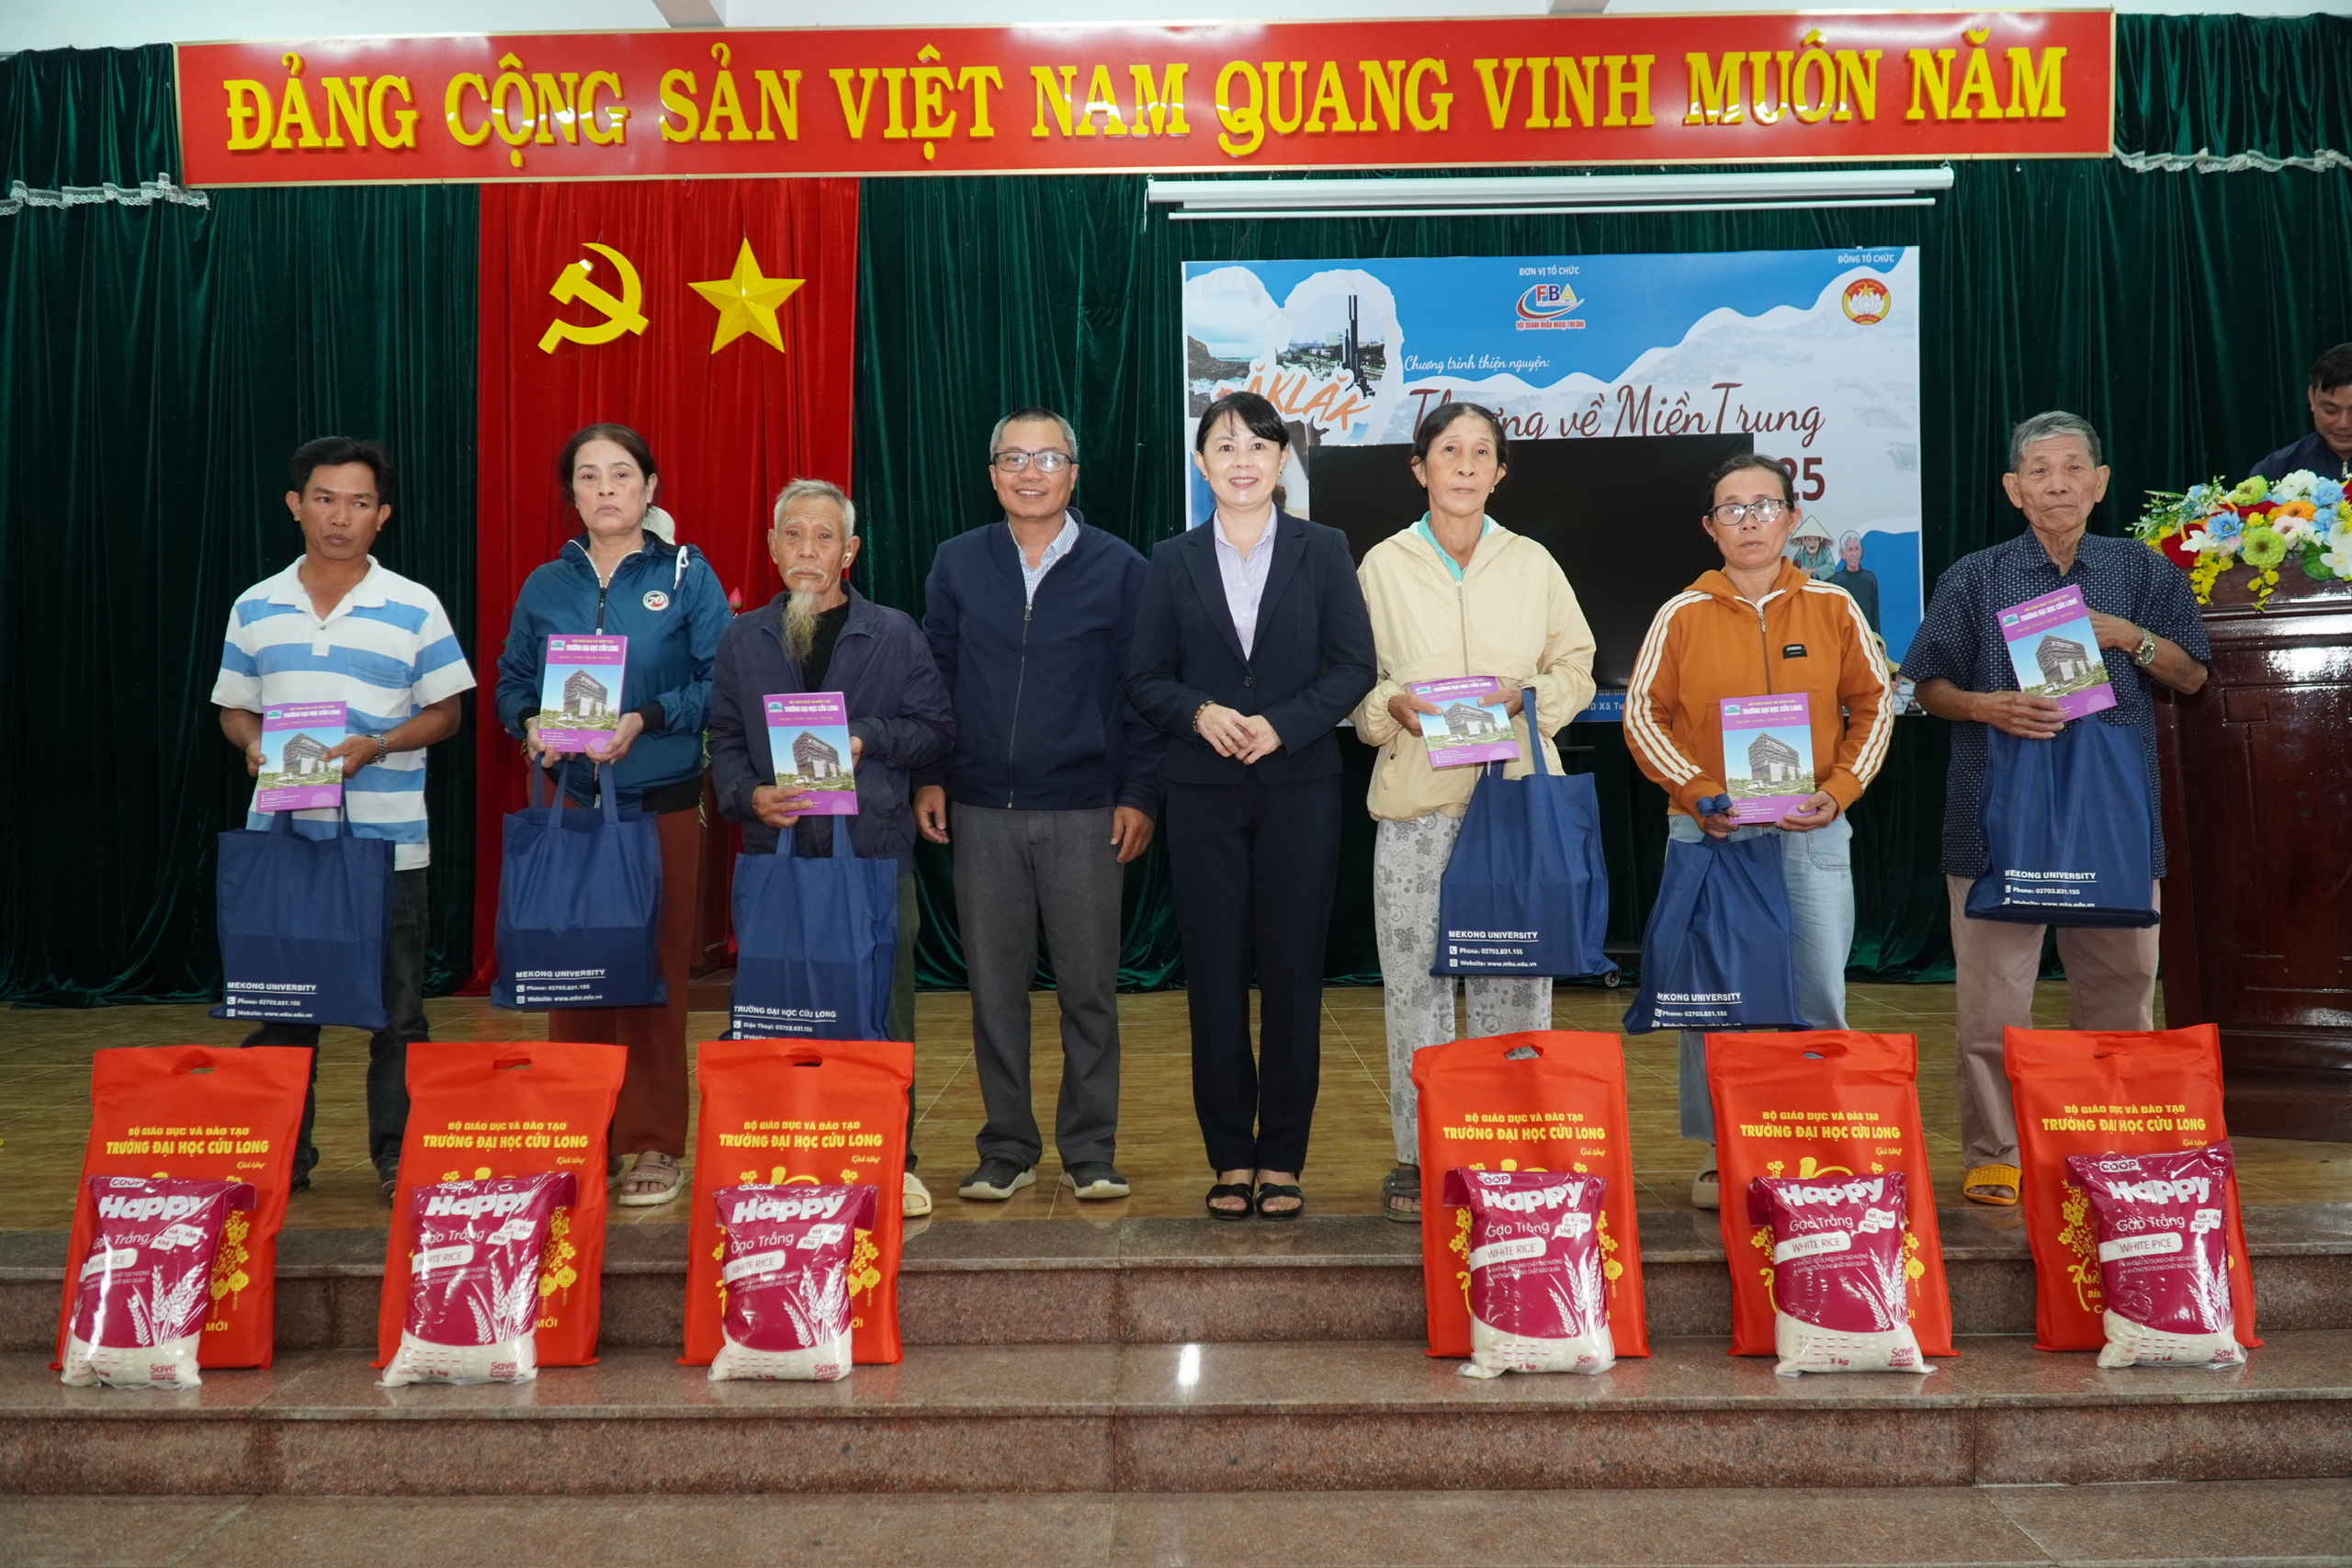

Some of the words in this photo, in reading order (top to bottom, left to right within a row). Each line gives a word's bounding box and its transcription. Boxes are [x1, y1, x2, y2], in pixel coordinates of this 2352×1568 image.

[224, 51, 417, 152] ĐẢNG
[446, 51, 630, 169] CỘNG
[659, 42, 800, 142] SẢN
[830, 42, 1003, 162] VIỆT
[1031, 63, 1191, 141] NAM
[1215, 58, 1454, 158] QUANG
[1474, 53, 1656, 131] VINH
[1683, 28, 1883, 127] MUÔN
[1905, 28, 2066, 122] NĂM
[1838, 254, 1860, 263] ĐỒNG
[1861, 253, 1871, 262] TỔ
[1873, 253, 1894, 262] CHỨC
[1520, 267, 1536, 276] ĐƠN
[1538, 267, 1545, 276] VỊ
[1547, 265, 1556, 275] TỔ
[1558, 265, 1579, 275] CHỨC
[1536, 284, 1577, 301] FBA
[1405, 355, 1445, 374] Chương
[1448, 355, 1476, 369] trình
[1478, 354, 1507, 371] thiện
[1509, 355, 1550, 372] nguyện:
[1712, 382, 1826, 447] Trung
[555, 969, 605, 977] UNIVERSITY
[1691, 993, 1740, 1001] UNIVERSITY
[734, 1005, 764, 1014] TRƯỜNG
[766, 1009, 779, 1017] ĐẠI
[781, 1010, 797, 1018] HỌC
[1763, 1111, 1777, 1121] BỘ
[1781, 1111, 1804, 1120] GIÁO
[1807, 1112, 1828, 1122] DỤC
[1831, 1111, 1845, 1121] VÀ
[1847, 1111, 1863, 1121] ĐÀO
[1866, 1112, 1878, 1122] TẠO
[2042, 1116, 2096, 1131] TRƯỜNG
[2099, 1119, 2116, 1134] ĐẠI
[2120, 1119, 2143, 1134] HỌC
[2147, 1115, 2173, 1131] CỬU
[2177, 1119, 2205, 1131] LONG
[744, 1121, 757, 1131] BỘ
[759, 1121, 779, 1130] GIÁO
[782, 1122, 801, 1132] DỤC
[804, 1120, 816, 1130] VÀ
[819, 1121, 839, 1130] ĐÀO
[842, 1122, 860, 1132] TẠO
[1443, 1124, 1493, 1140] TRƯỜNG
[1497, 1128, 1518, 1143] ĐẠI
[1522, 1127, 1545, 1143] HỌC
[1550, 1123, 1572, 1139] CỬU
[1576, 1127, 1605, 1140] LONG
[1740, 1122, 1792, 1138] TRƯỜNG
[1795, 1125, 1817, 1141] ĐẠI
[1822, 1125, 1849, 1141] HỌC
[1851, 1122, 1871, 1138] CỬU
[1872, 1127, 1900, 1139] LONG
[107, 1138, 149, 1155] TRƯỜNG
[152, 1142, 174, 1156] ĐẠI
[178, 1141, 204, 1156] HỌC
[208, 1137, 232, 1155] CỬU
[235, 1141, 268, 1153] LONG
[423, 1134, 473, 1148] TRƯỜNG
[476, 1136, 497, 1152] ĐẠI
[500, 1136, 522, 1152] HỌC
[525, 1132, 552, 1148] CỬU
[554, 1135, 588, 1148] LONG
[719, 1133, 768, 1147] TRƯỜNG
[771, 1134, 790, 1151] ĐẠI
[794, 1135, 818, 1152] HỌC
[821, 1132, 844, 1147] CỬU
[849, 1134, 882, 1146] LONG
[2101, 1161, 2137, 1171] COOP
[111, 1178, 143, 1187] COOP
[2107, 1176, 2211, 1204] Happy
[1480, 1182, 1584, 1213] Happy
[1777, 1178, 1883, 1206] Happy
[99, 1195, 209, 1222] Happy
[424, 1192, 535, 1220] Happy
[732, 1194, 847, 1223] Happy
[1790, 1218, 1815, 1232] Gạo
[1819, 1214, 1853, 1229] Trắng
[2149, 1213, 2185, 1229] Trắng
[1487, 1223, 1512, 1237] Gạo
[731, 1240, 753, 1254] Gạo
[758, 1231, 794, 1247] Trắng
[1487, 1247, 1513, 1258] WHITE
[1517, 1244, 1535, 1253] RICE
[1792, 1241, 1819, 1253] WHITE
[1822, 1238, 1840, 1247] RICE
[2120, 1240, 2149, 1253] WHITE
[2153, 1239, 2172, 1247] RICE
[731, 1263, 753, 1275] WHITE
[755, 1258, 774, 1269] RICE
[206, 1321, 228, 1332] MỚI
[1892, 1347, 1914, 1357] Save
[815, 1364, 839, 1372] Save
[1838, 1358, 1849, 1367] kg
